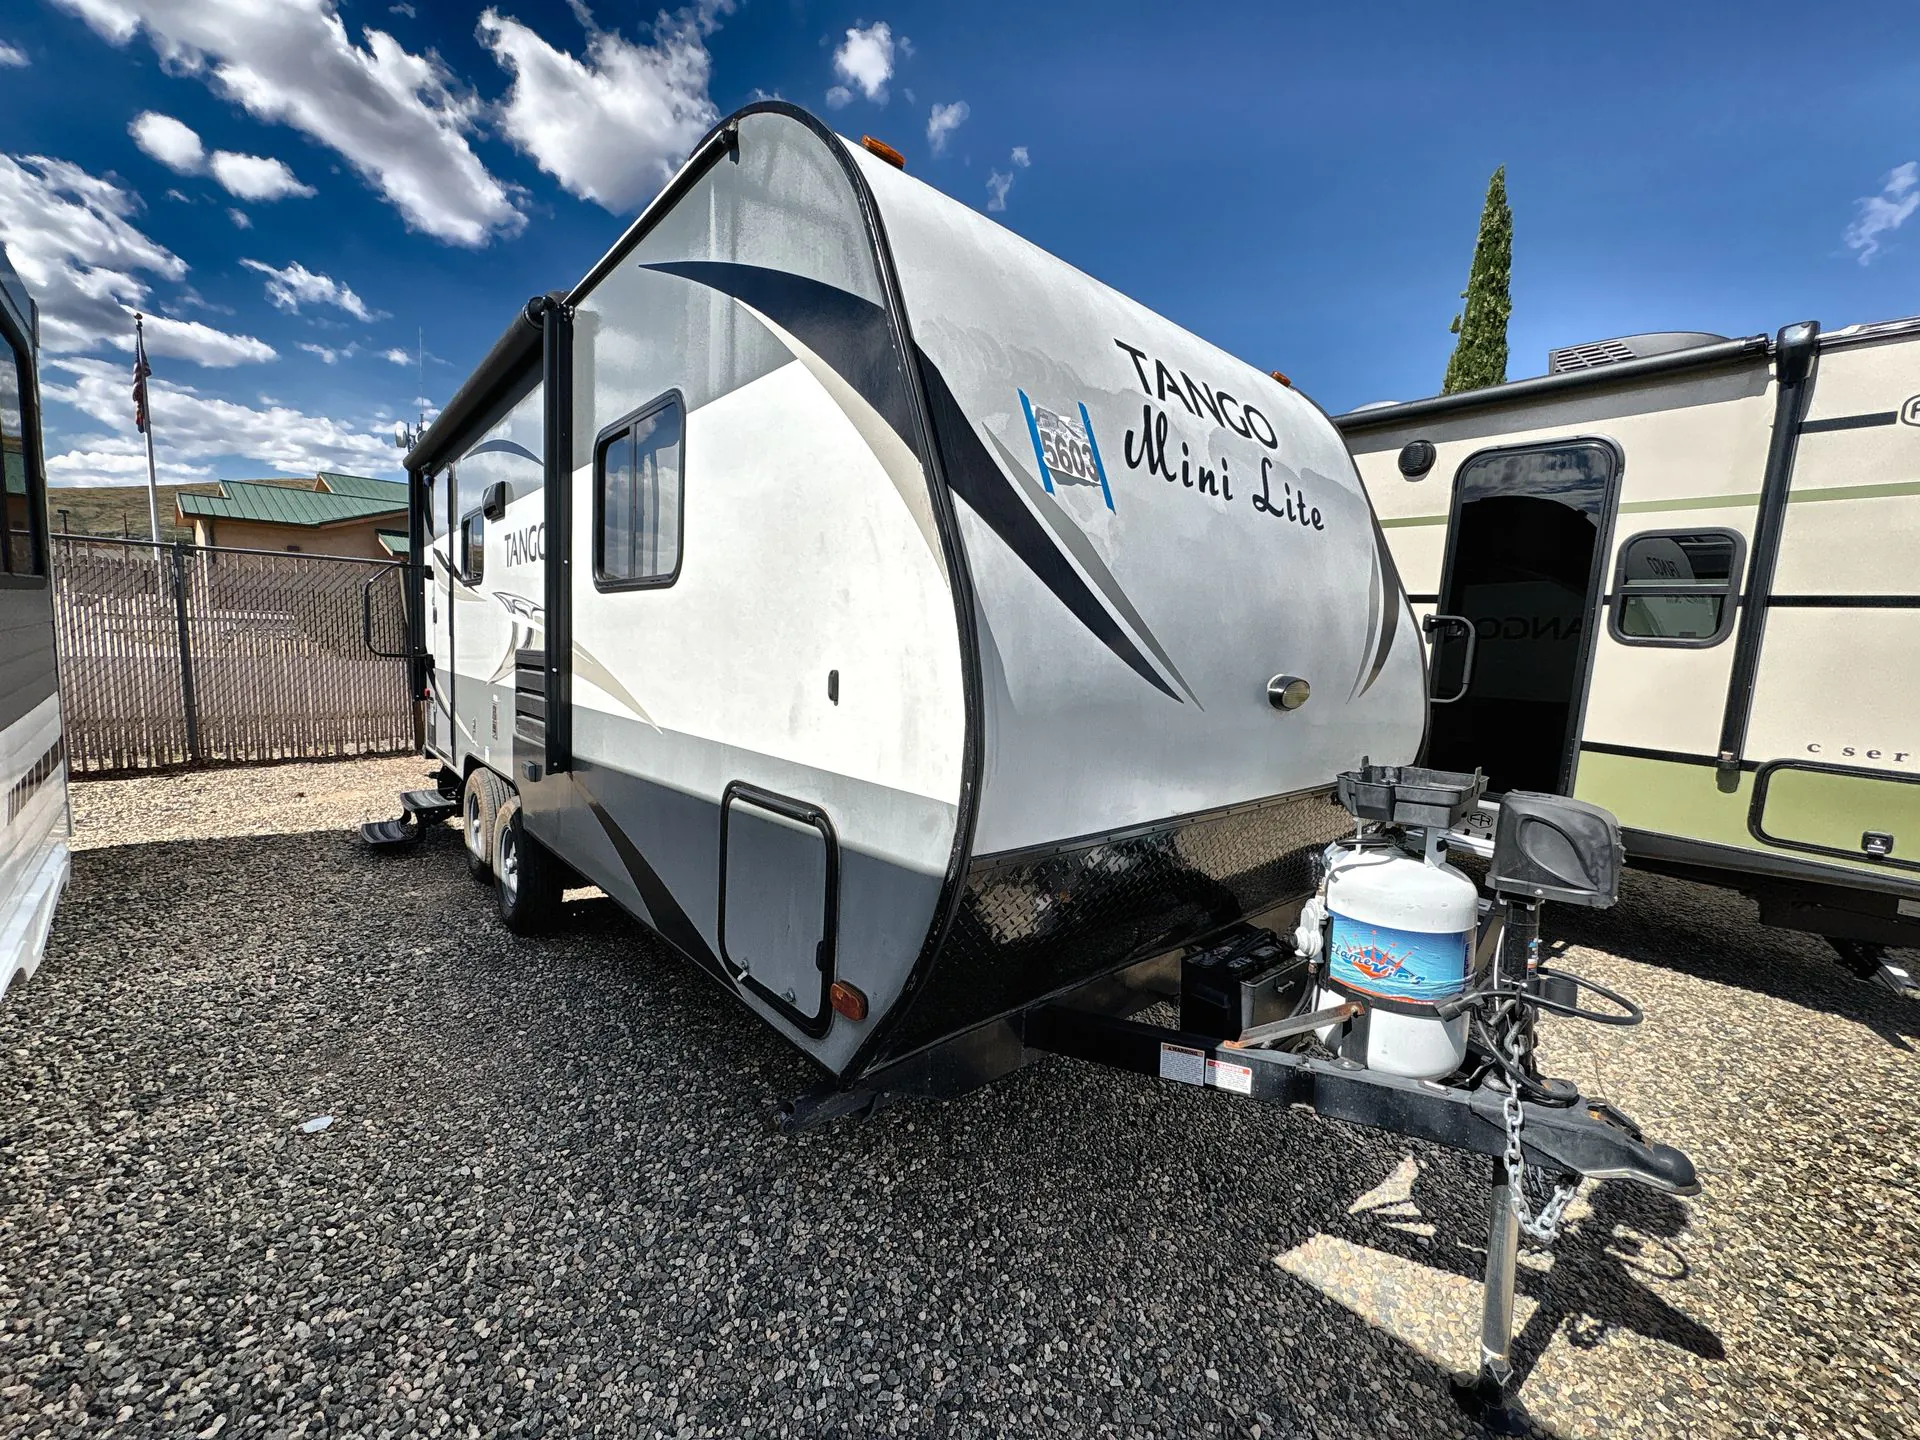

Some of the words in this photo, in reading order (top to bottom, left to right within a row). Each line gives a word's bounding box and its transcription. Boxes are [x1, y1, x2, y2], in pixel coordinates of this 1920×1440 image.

[1113, 337, 1278, 449] TANGO
[1040, 429, 1099, 482] 5603
[1124, 404, 1233, 500] Mini
[1252, 457, 1324, 530] Lite
[1806, 743, 1821, 753] c
